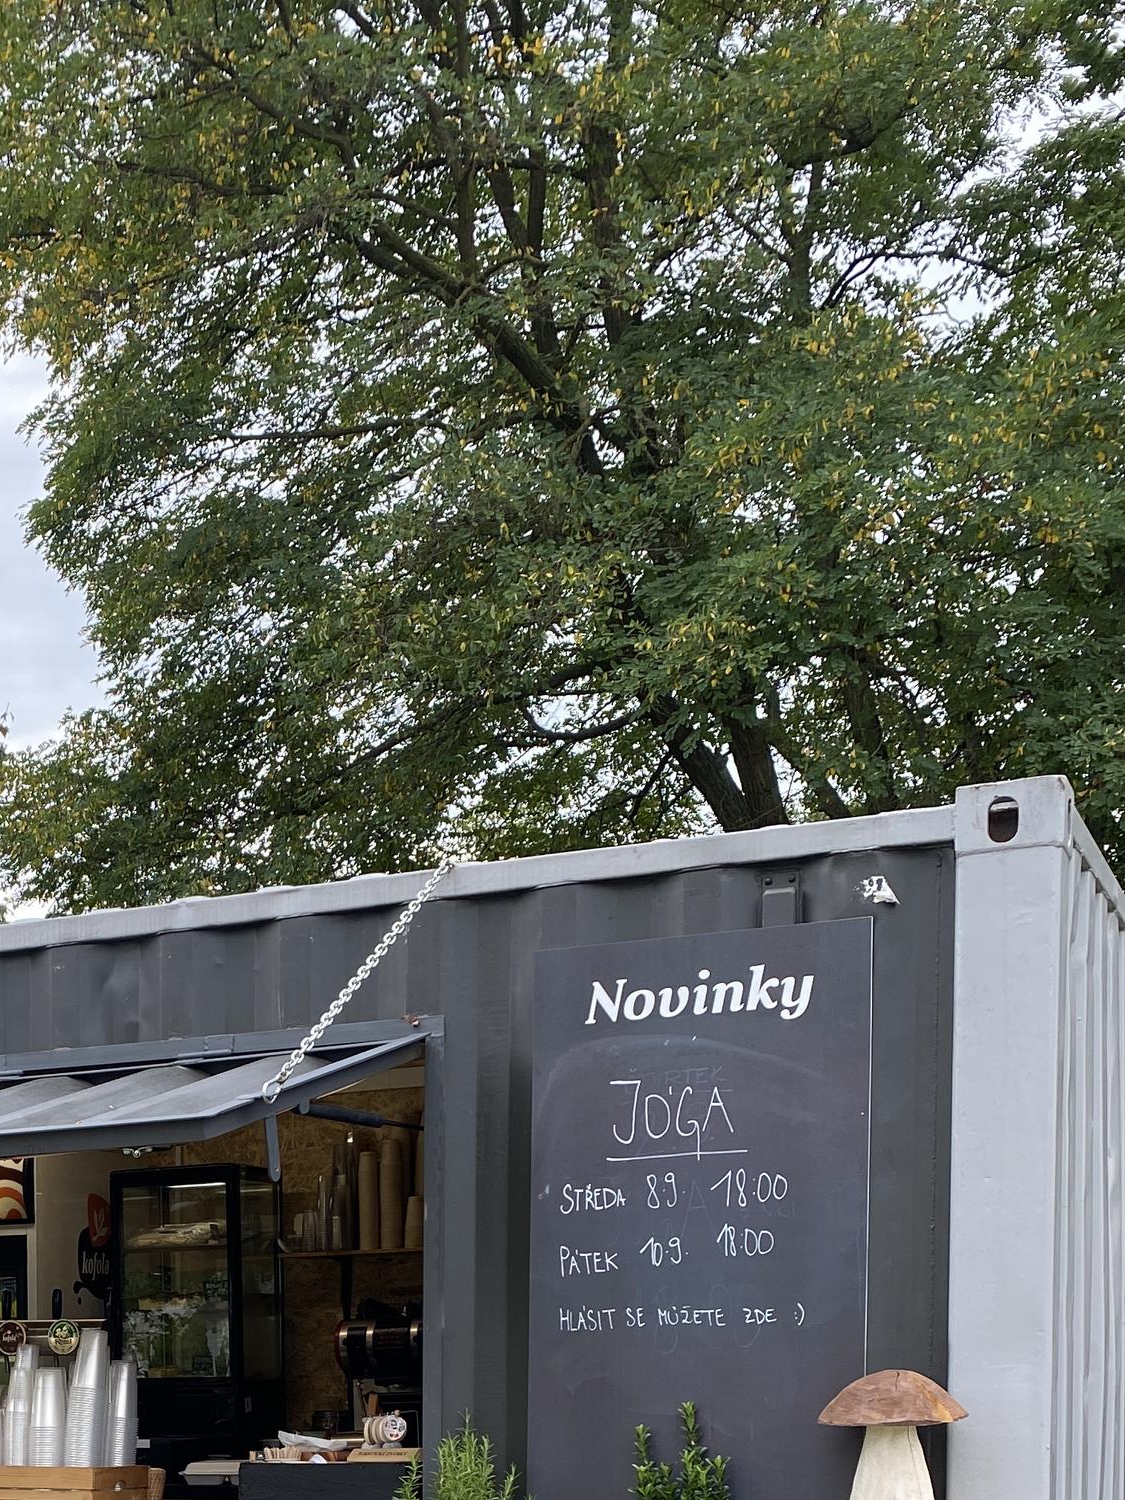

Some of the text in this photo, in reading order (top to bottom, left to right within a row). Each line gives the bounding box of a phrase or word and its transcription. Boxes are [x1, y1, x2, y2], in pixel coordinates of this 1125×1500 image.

[584, 963, 814, 1025] Novinky
[609, 1079, 734, 1161] JÓGA
[559, 1184, 626, 1215] STŘEDA
[710, 1168, 788, 1208] 18:00
[82, 1250, 110, 1280] kofola
[559, 1222, 775, 1278] PÁTEK 10.9. 18:00
[559, 1303, 616, 1332] HLÁSIT
[626, 1306, 646, 1327] SE
[658, 1304, 727, 1327] MŮŽETE
[743, 1306, 778, 1324] ZDE
